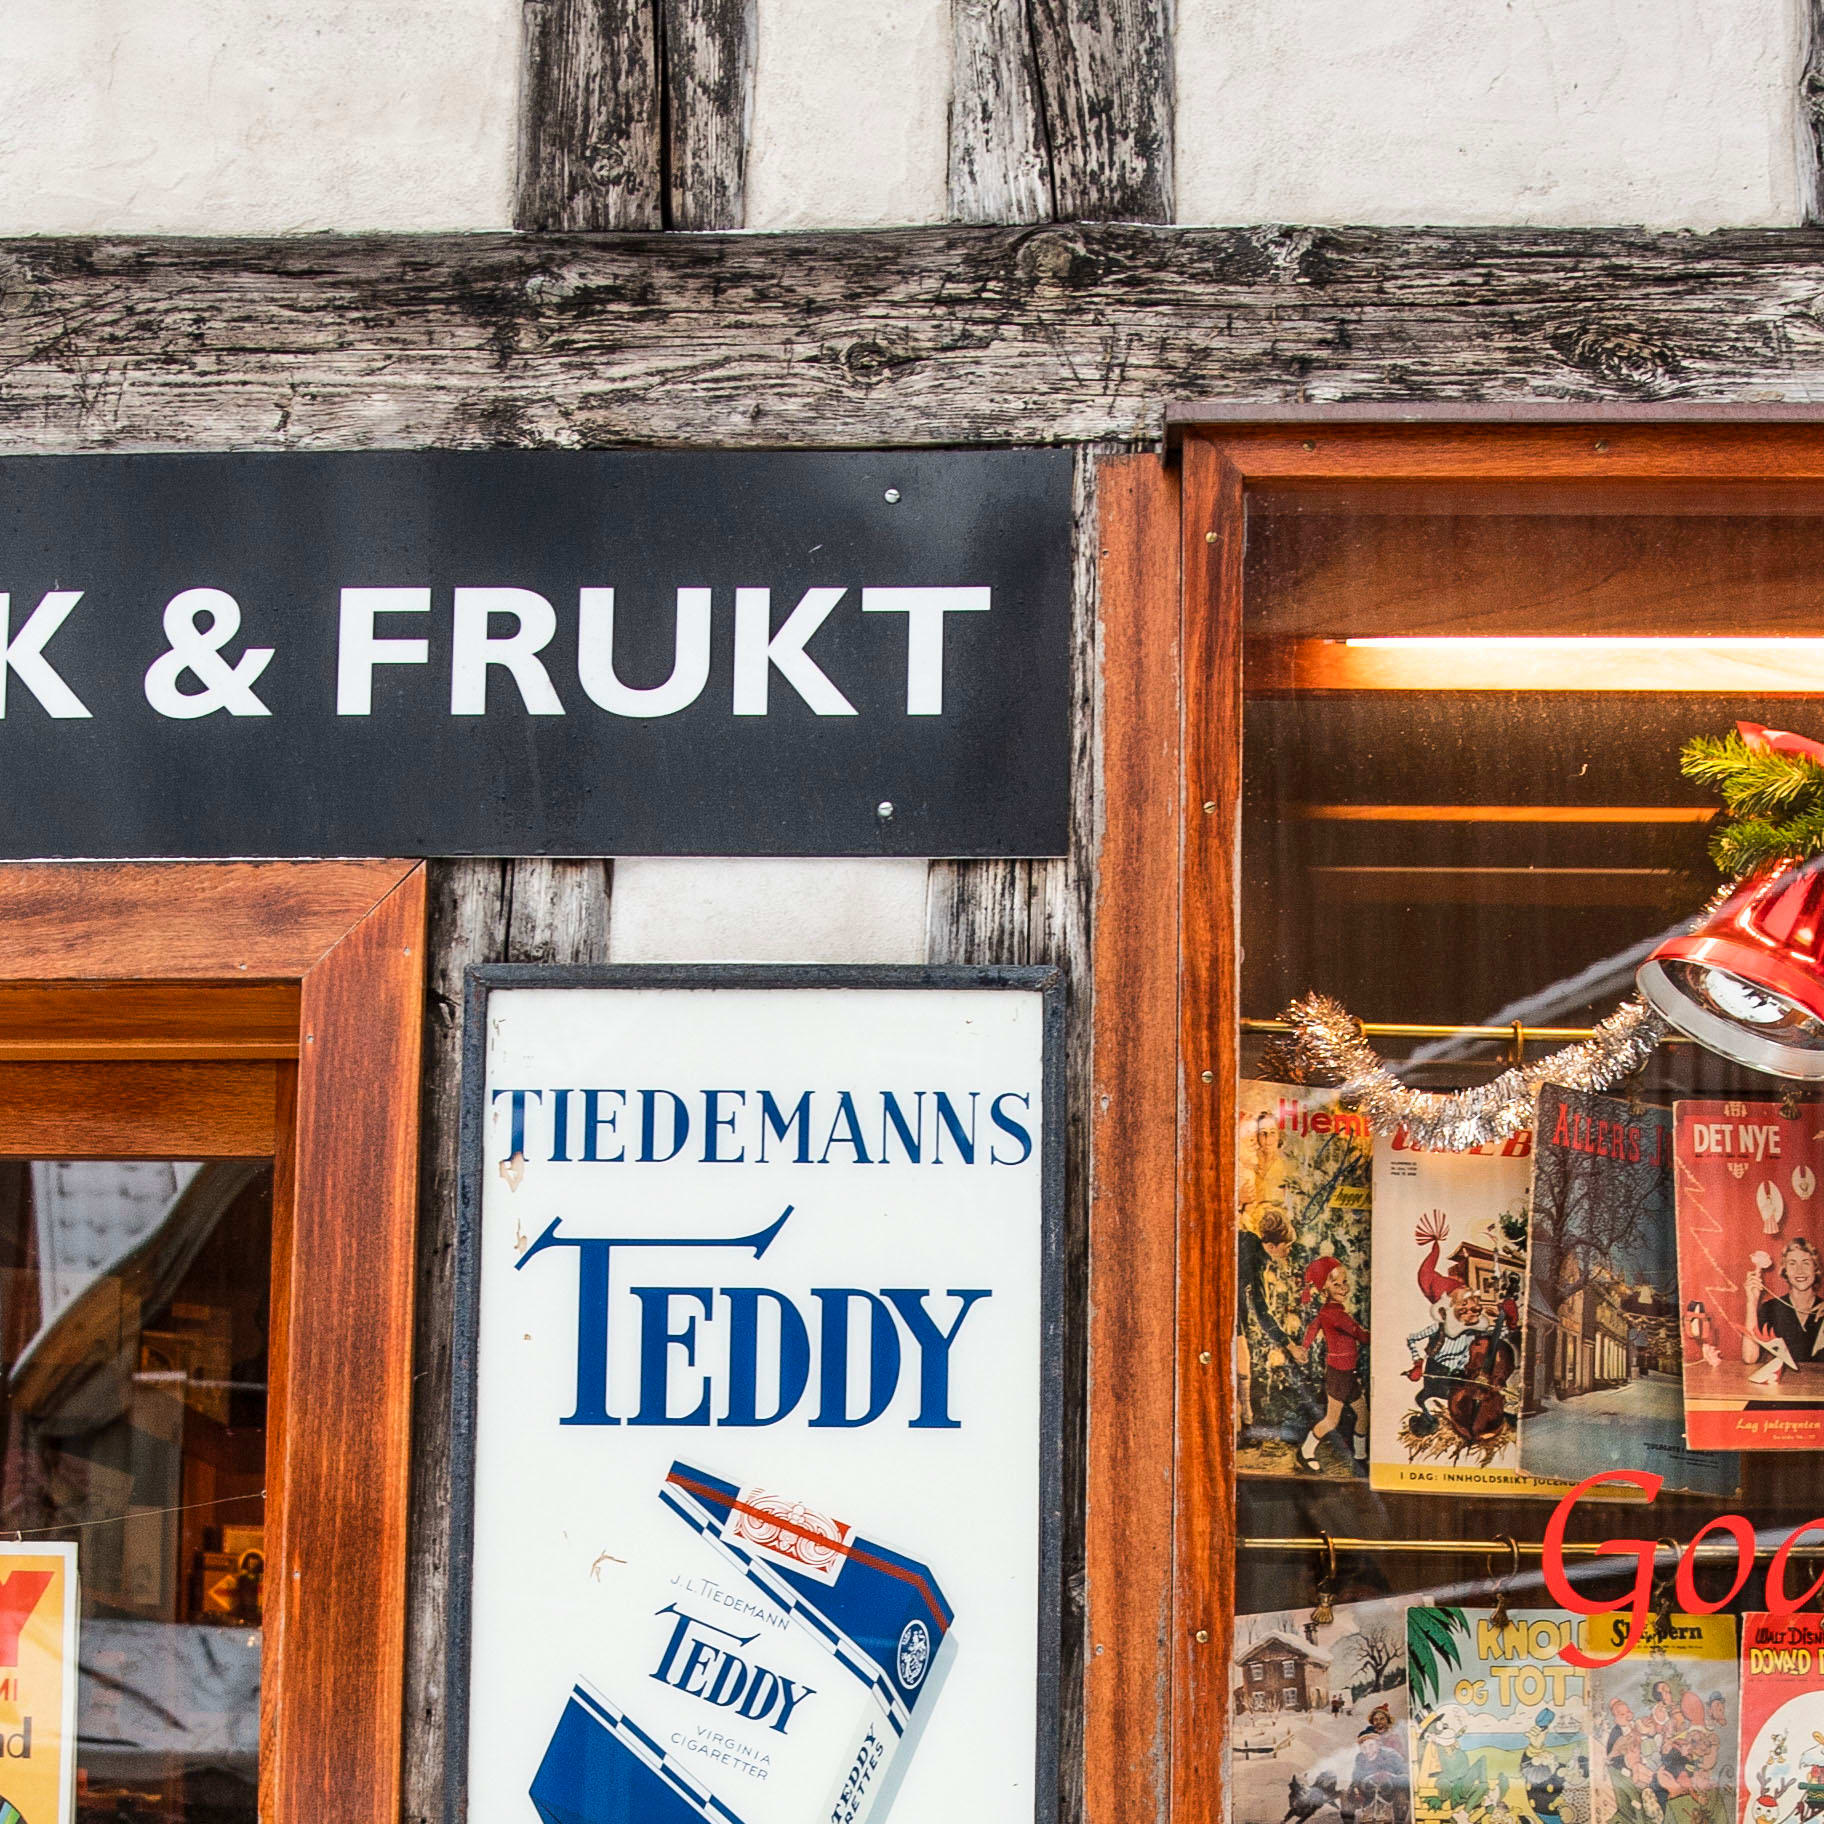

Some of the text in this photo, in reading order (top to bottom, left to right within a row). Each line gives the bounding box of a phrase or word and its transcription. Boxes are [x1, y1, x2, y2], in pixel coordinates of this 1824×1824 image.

[143, 587, 275, 719] &
[335, 585, 991, 718] FRUKT
[492, 1089, 1033, 1166] TIEDEMANNS
[1552, 1103, 1642, 1164] ALLERS
[1693, 1123, 1781, 1162] DET NYE
[514, 1205, 993, 1429] TEDDY
[1737, 1418, 1758, 1432] Lag
[1409, 1471, 1438, 1481] DAG:
[1443, 1473, 1528, 1486] INNHOLDSRIKT
[1755, 1627, 1787, 1645] WALT
[648, 1601, 818, 1736] TEDDY
[1750, 1648, 1812, 1677] DONALD
[1454, 1678, 1489, 1707] OG
[670, 1732, 770, 1782] CIGARETTER
[696, 1725, 772, 1767] VIRGINIA
